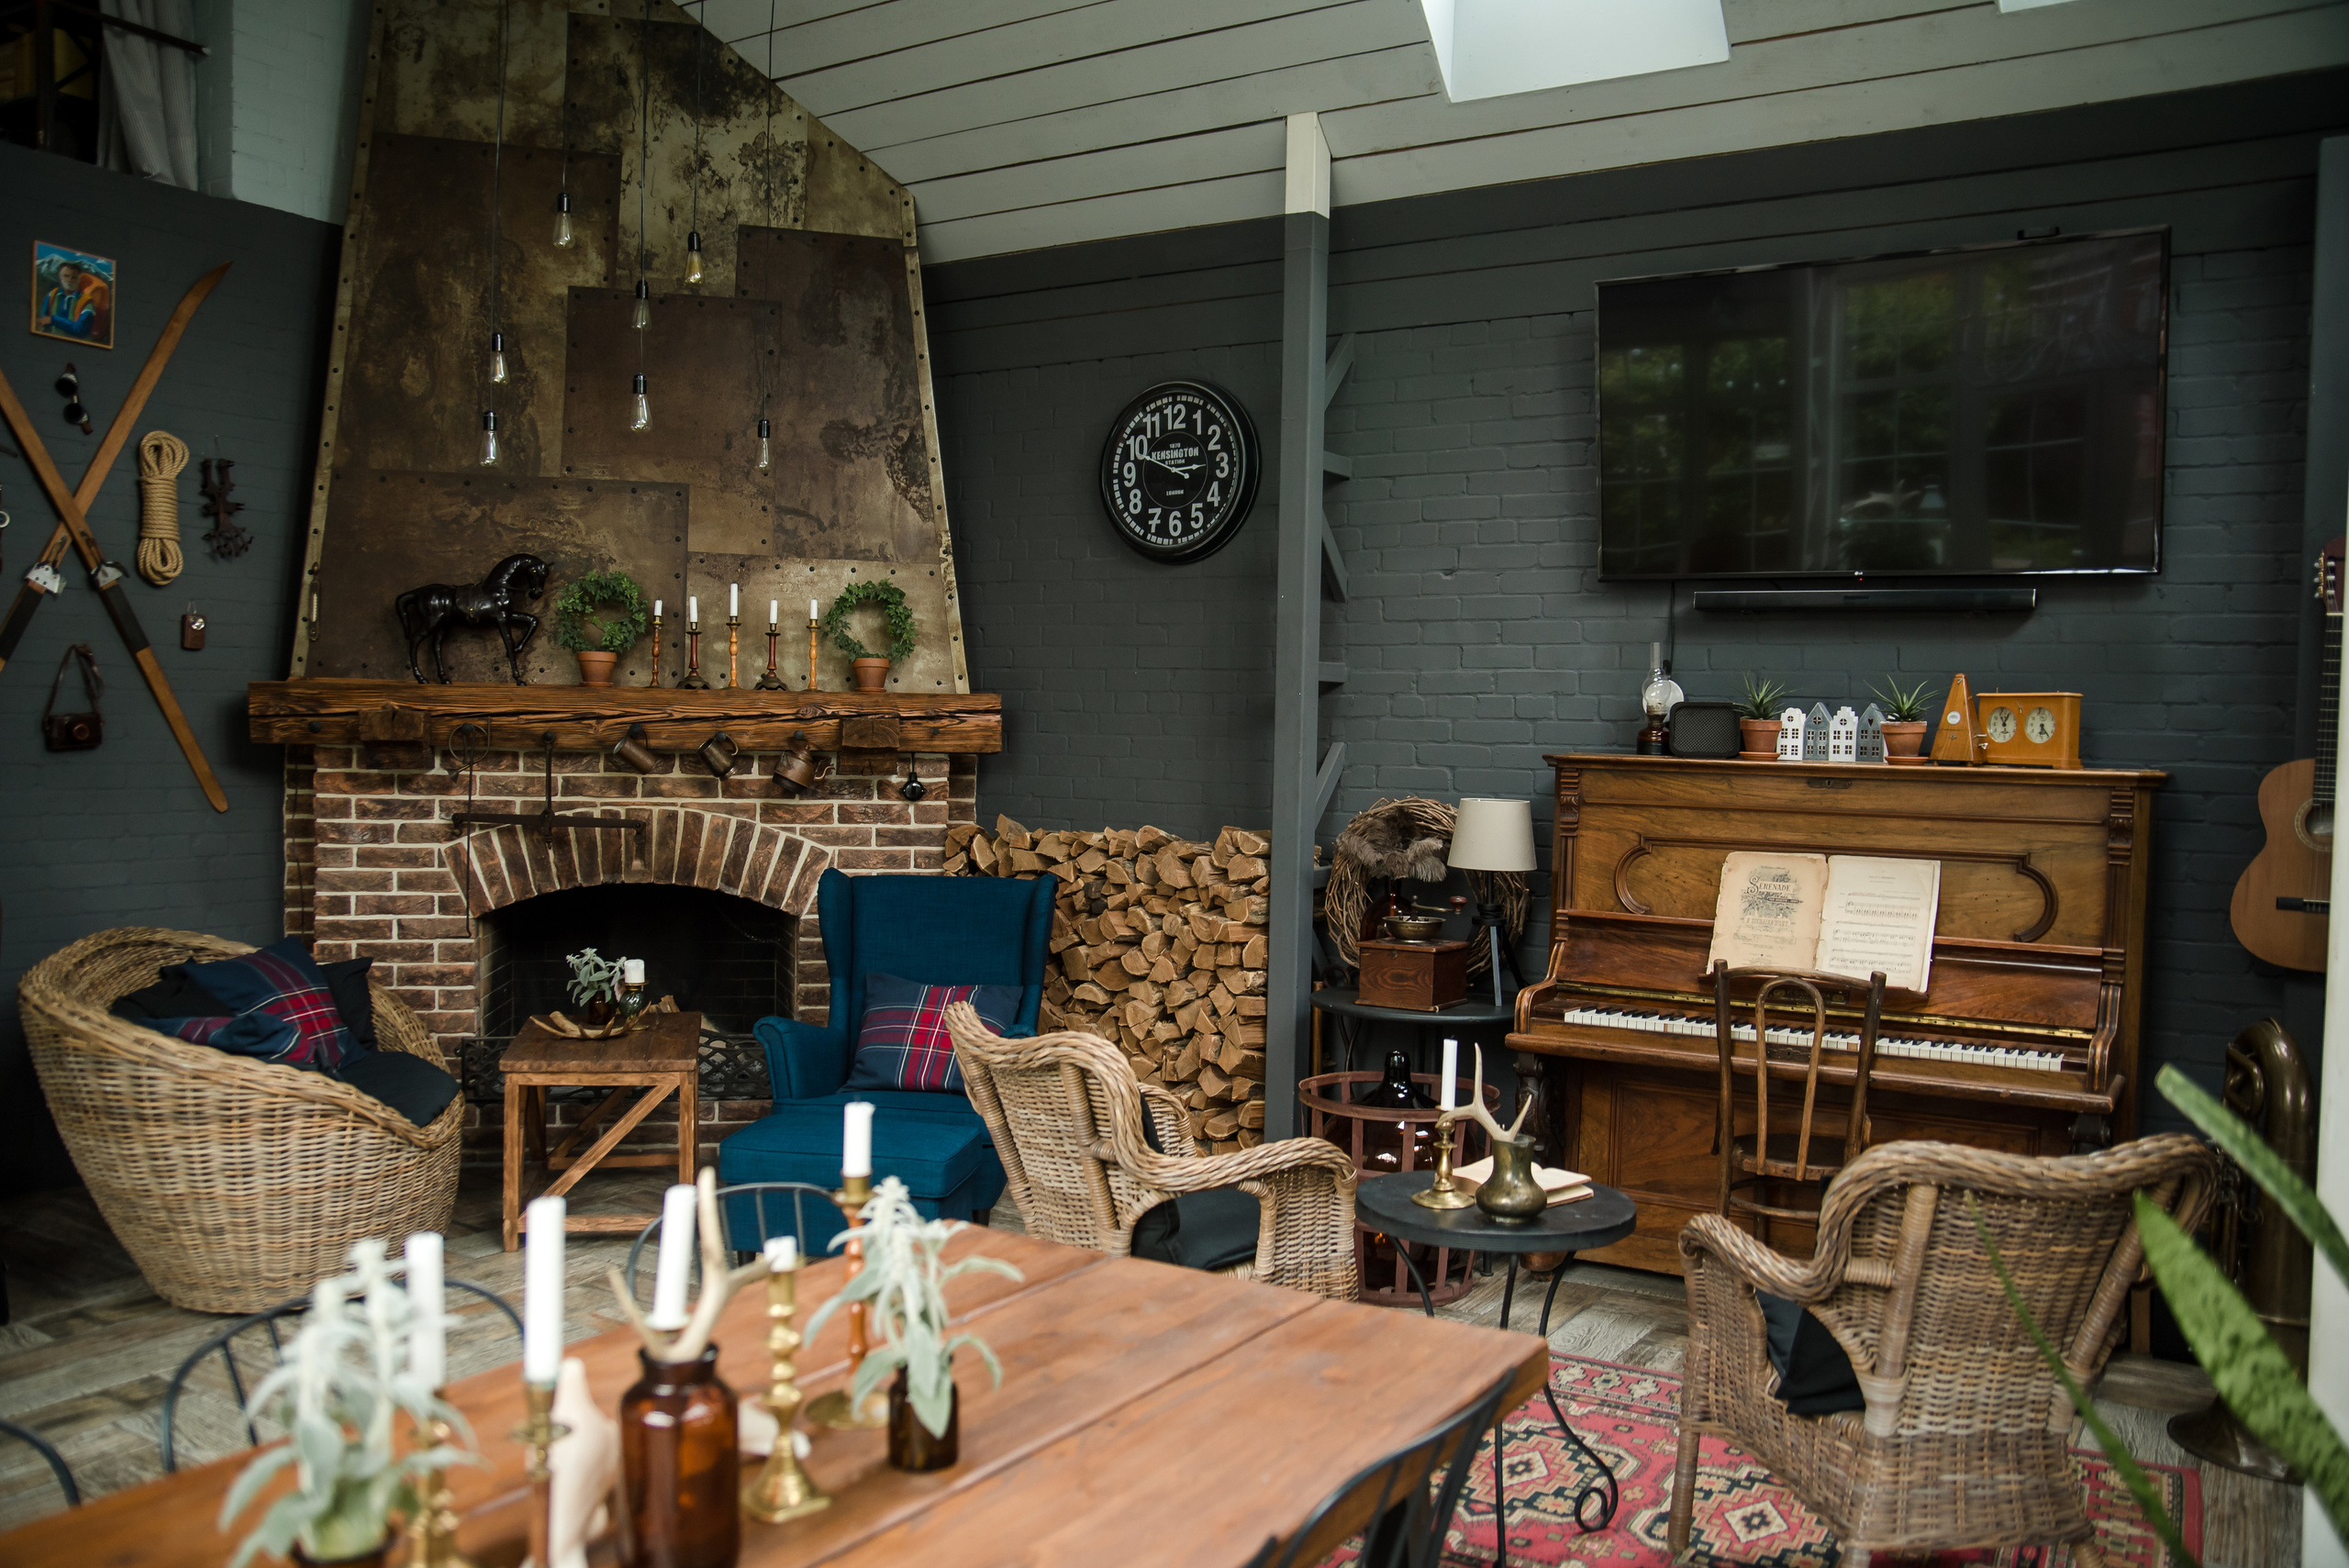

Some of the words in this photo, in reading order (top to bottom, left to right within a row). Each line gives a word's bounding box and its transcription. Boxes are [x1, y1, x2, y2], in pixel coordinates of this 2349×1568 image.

[1143, 412, 1161, 439] 11
[1163, 403, 1186, 430] 12
[1192, 409, 1202, 436] 1
[1126, 433, 1149, 461] 10
[1208, 424, 1221, 450] 2
[1152, 447, 1198, 461] KENSINGTON
[1216, 452, 1230, 478] 3
[1123, 462, 1137, 488] 9
[1129, 489, 1141, 515] 8
[1207, 481, 1221, 507] 4
[1148, 507, 1162, 533] 7
[1168, 510, 1182, 538] 6
[1189, 502, 1204, 529] 5
